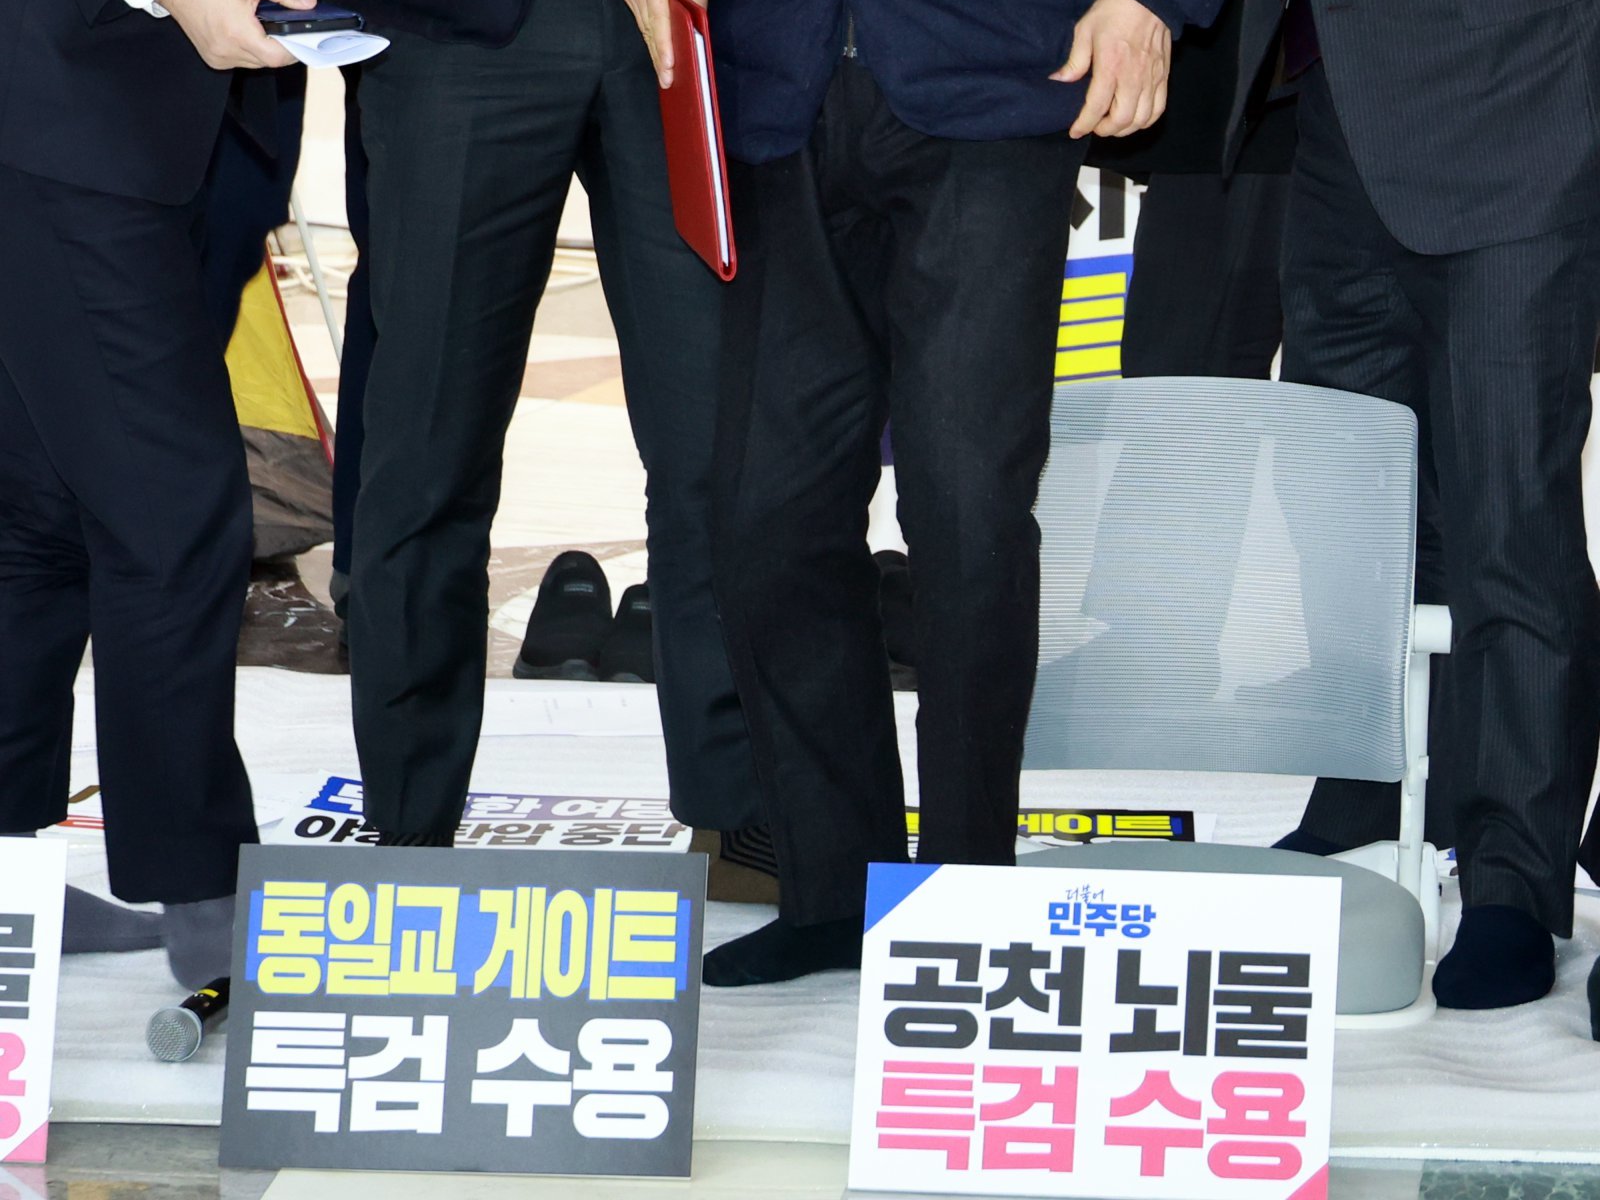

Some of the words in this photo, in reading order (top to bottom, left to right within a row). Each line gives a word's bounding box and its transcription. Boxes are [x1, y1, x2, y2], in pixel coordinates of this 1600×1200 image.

[559, 823, 688, 847] 중단
[1065, 884, 1105, 904] 더불어
[256, 880, 461, 995] 통일교
[473, 886, 679, 1000] 게이트
[1048, 902, 1157, 938] 민주당
[883, 940, 1086, 1052] 공천
[1109, 949, 1313, 1059] 뇌물
[245, 1011, 450, 1134] 특검
[470, 1017, 673, 1140] 수용
[876, 1060, 1079, 1173] 특검
[1104, 1069, 1307, 1180] 수용
